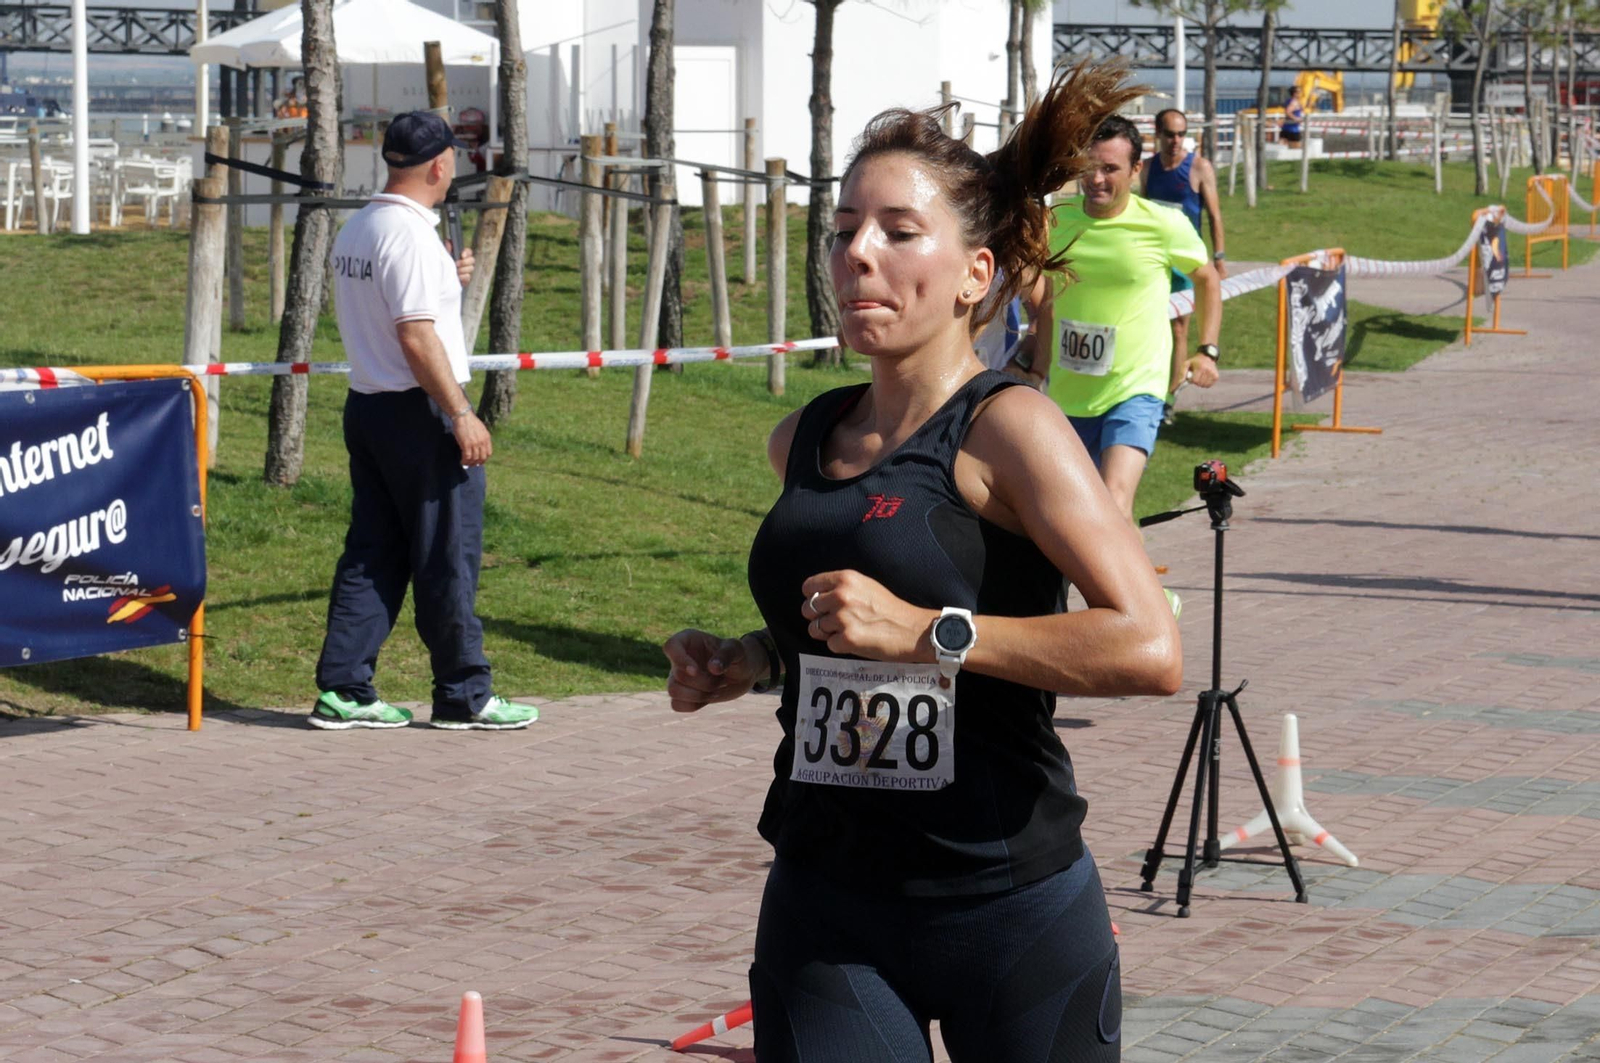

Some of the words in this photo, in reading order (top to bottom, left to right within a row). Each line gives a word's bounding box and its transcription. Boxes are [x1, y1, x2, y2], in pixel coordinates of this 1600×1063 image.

[1061, 328, 1105, 361] 4060
[0, 498, 127, 574] segur@
[64, 571, 139, 586] POLICÍA
[62, 586, 152, 603] NACIONAL
[873, 674, 885, 683] DE
[886, 674, 899, 684] LA
[901, 673, 937, 685] POLICÍA
[803, 686, 940, 772] 3328
[872, 775, 950, 790] DEPORTIVA
